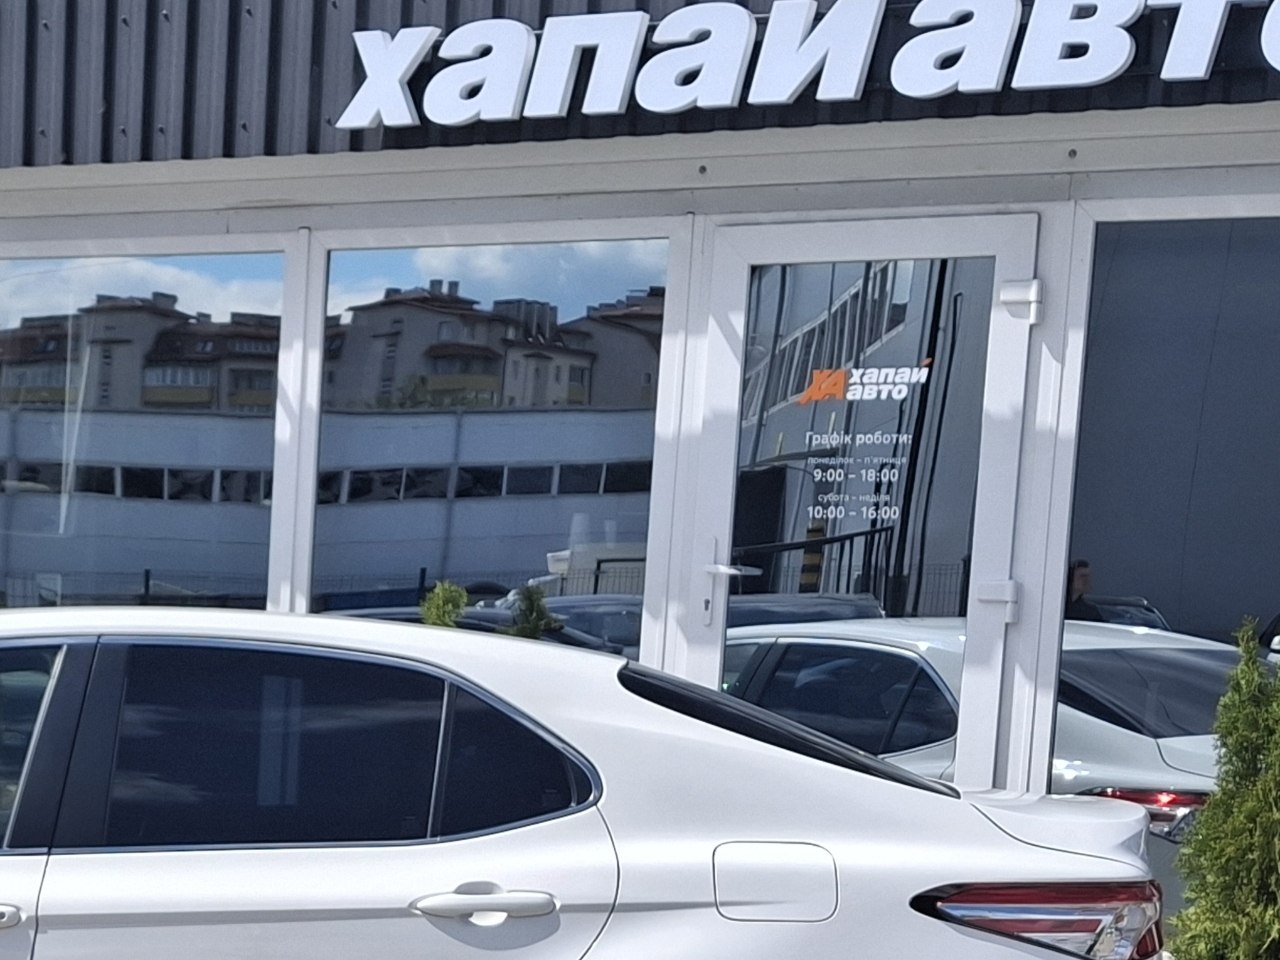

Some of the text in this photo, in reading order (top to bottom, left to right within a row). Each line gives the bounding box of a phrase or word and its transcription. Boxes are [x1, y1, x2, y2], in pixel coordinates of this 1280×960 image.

[848, 357, 931, 384] хапай
[846, 384, 908, 400] авто
[806, 431, 913, 448] Графік роботи:
[813, 468, 844, 482] 9:00
[860, 469, 899, 483] 18:00
[807, 505, 845, 519] 10:00
[861, 505, 899, 519] 16:00
